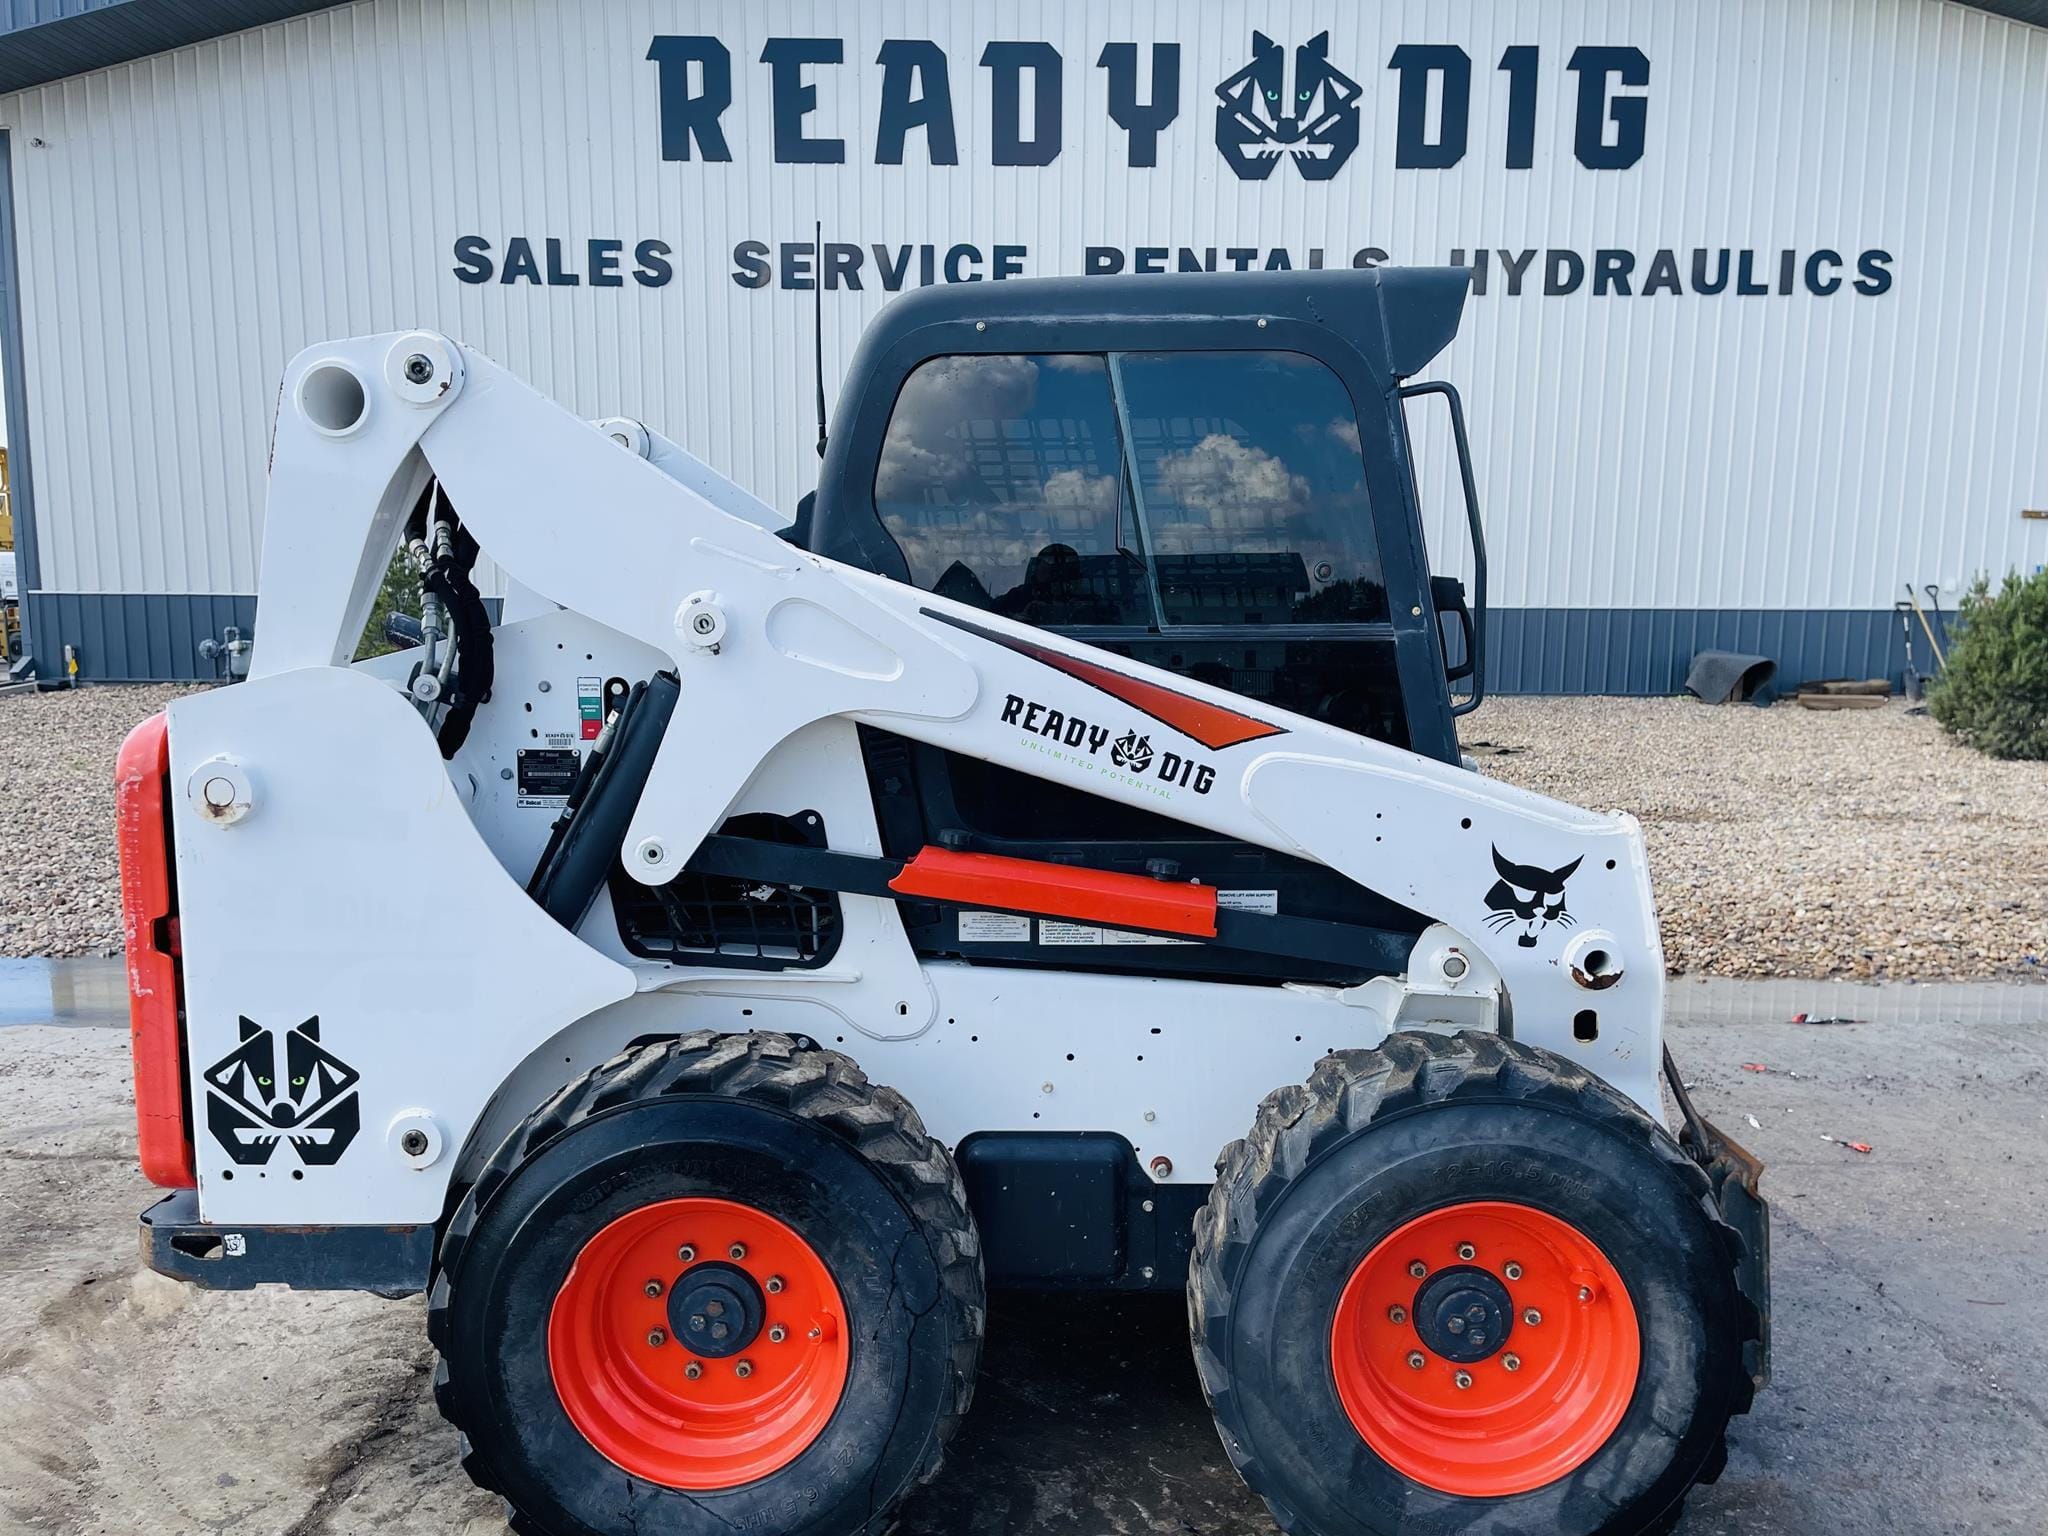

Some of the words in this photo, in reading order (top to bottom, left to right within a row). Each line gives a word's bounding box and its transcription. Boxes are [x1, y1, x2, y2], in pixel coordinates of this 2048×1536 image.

[646, 35, 1180, 168] READY
[452, 235, 673, 288] SALES
[733, 240, 1027, 291] SERVICE
[1450, 248, 1894, 297] HYDRAULICS
[1000, 693, 1110, 755] READY
[1020, 738, 1094, 771] UNLIMITED
[1100, 767, 1172, 800] POTENTIAL
